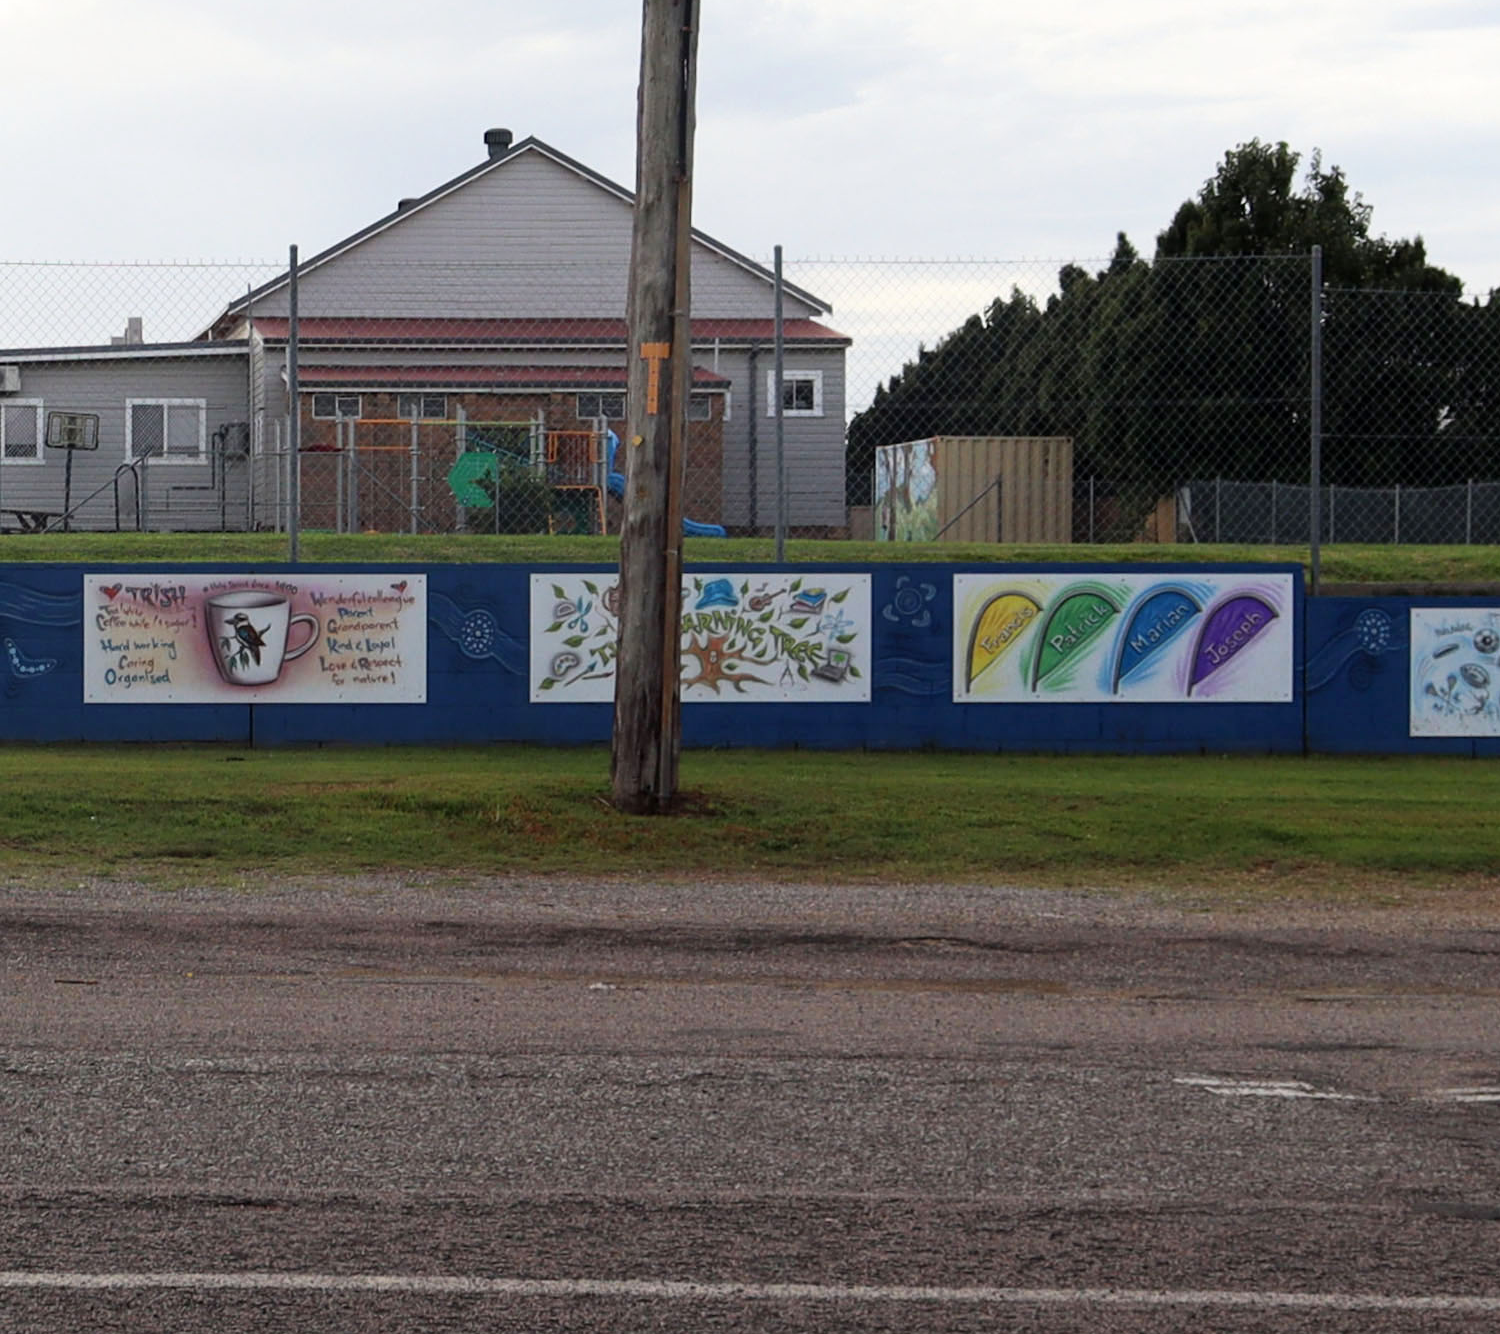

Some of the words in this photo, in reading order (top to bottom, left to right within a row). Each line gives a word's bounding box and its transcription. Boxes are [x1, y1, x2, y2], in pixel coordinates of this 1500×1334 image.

[980, 605, 1035, 655] Francis
[1049, 603, 1110, 655] Patrick
[1128, 603, 1190, 655] Marian
[1203, 610, 1264, 666] Joseph
[118, 655, 154, 675] Caring
